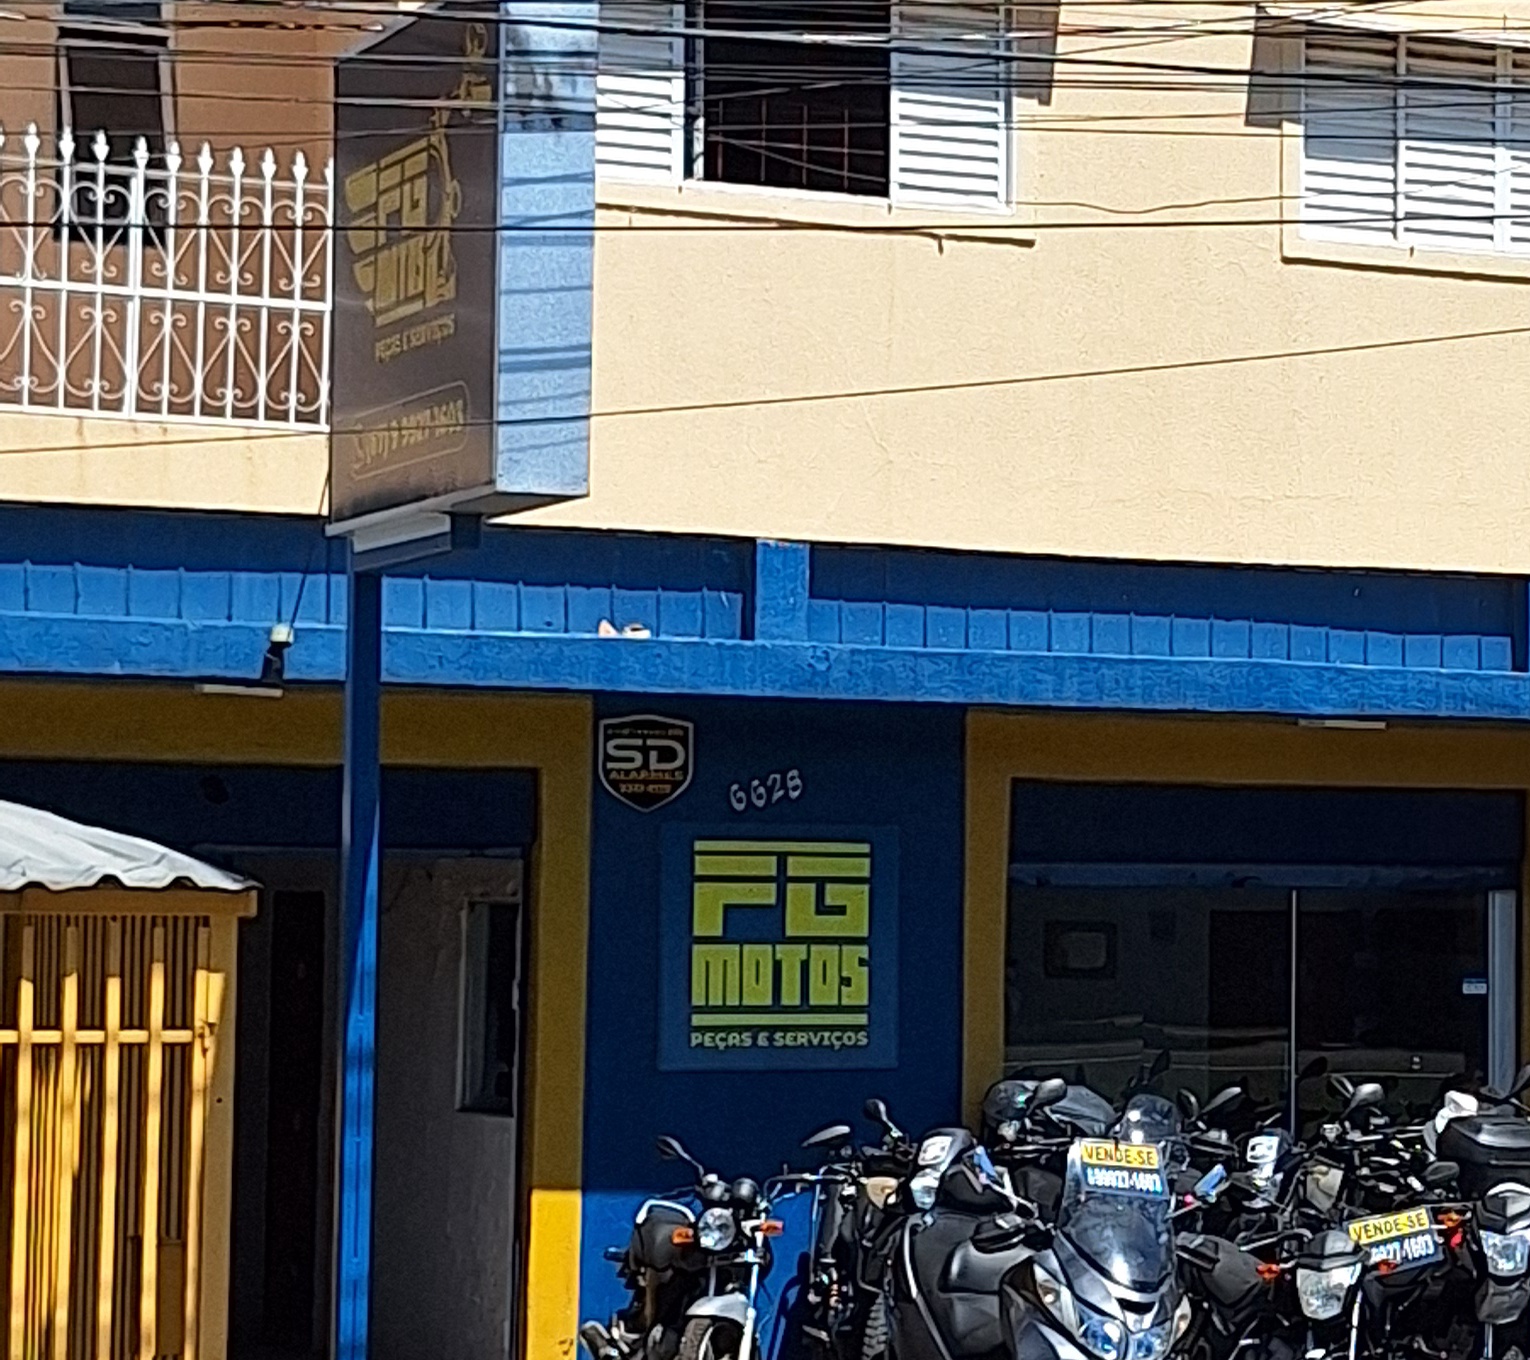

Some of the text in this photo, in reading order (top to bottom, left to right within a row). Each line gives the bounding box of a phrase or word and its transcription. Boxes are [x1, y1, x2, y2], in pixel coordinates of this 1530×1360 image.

[606, 738, 686, 770] SD
[730, 769, 803, 812] 6628
[694, 855, 871, 938] FG
[691, 943, 870, 1007] MOTOS
[690, 1031, 868, 1051] PEÇAS E SERVIÇOS
[1084, 1144, 1156, 1166] VENDE-SE
[1353, 1212, 1427, 1240] VENDE-SE
